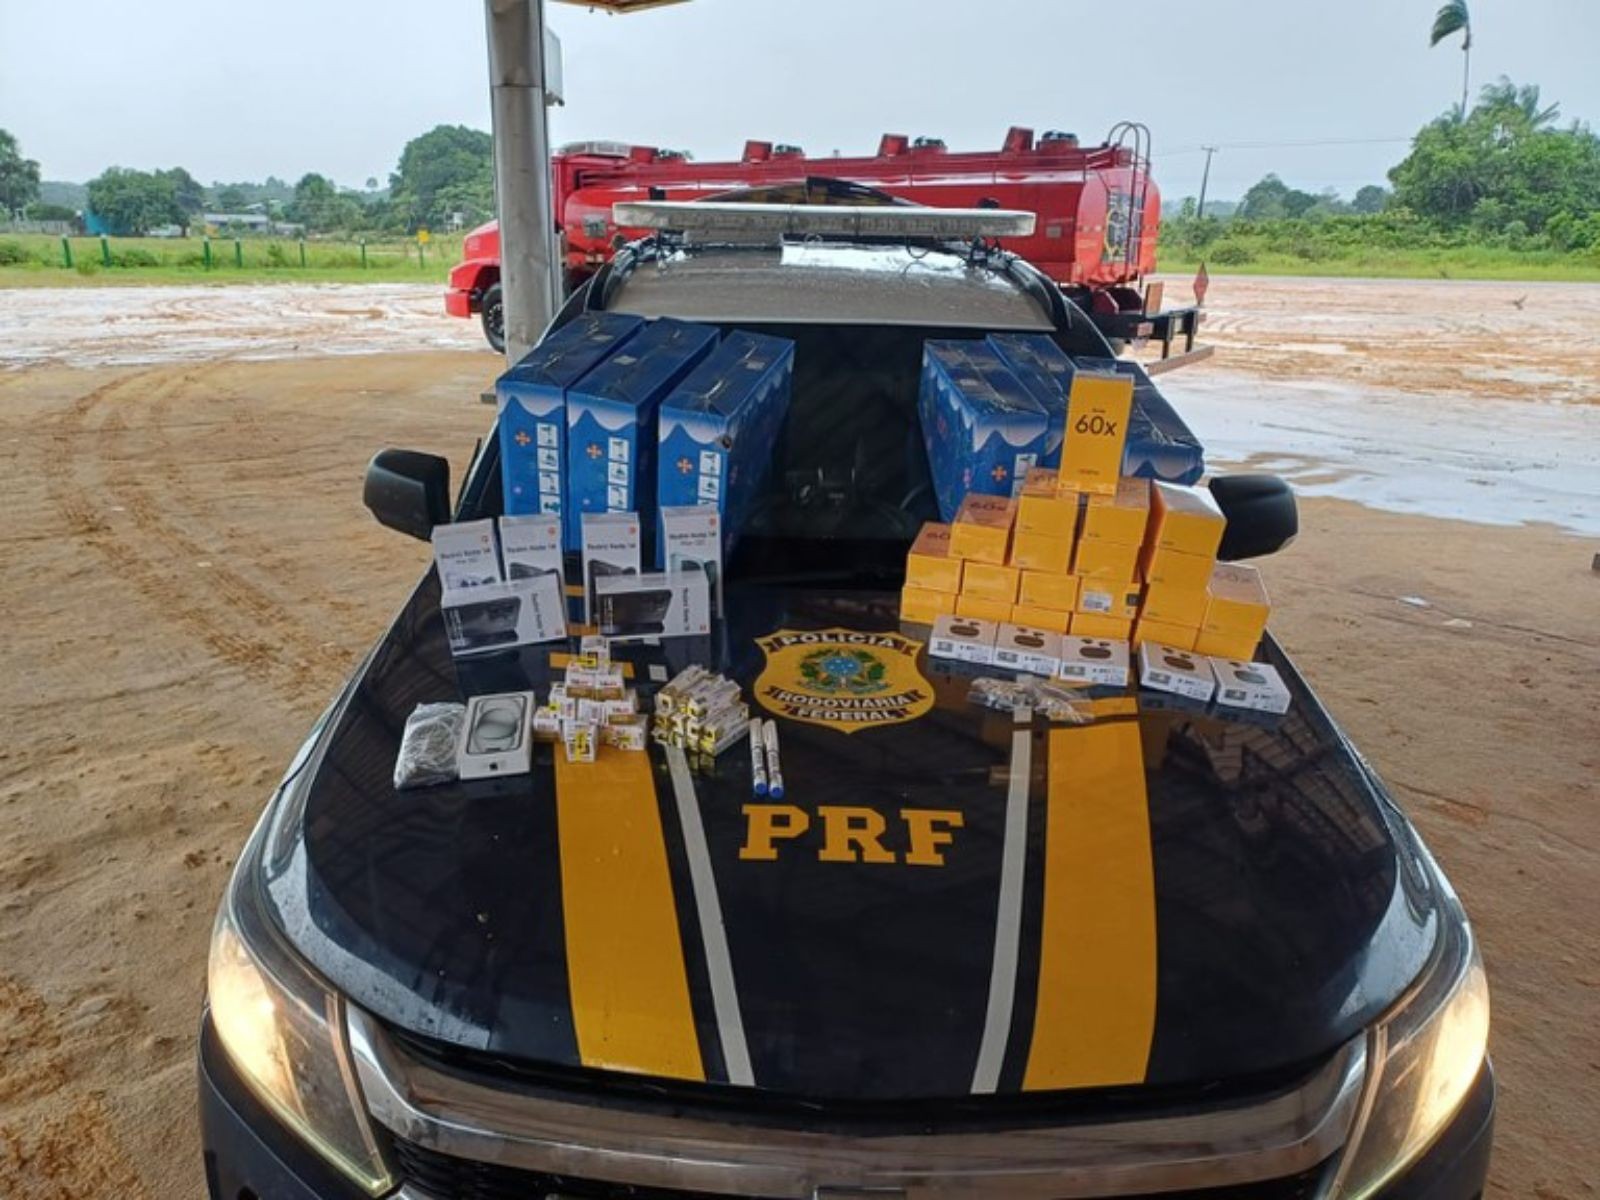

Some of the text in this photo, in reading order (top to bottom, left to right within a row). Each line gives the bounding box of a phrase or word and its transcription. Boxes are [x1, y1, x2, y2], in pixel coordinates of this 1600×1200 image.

[1074, 414, 1117, 437] 60x
[797, 708, 896, 721] FEDERAL
[739, 804, 965, 865] PRF
